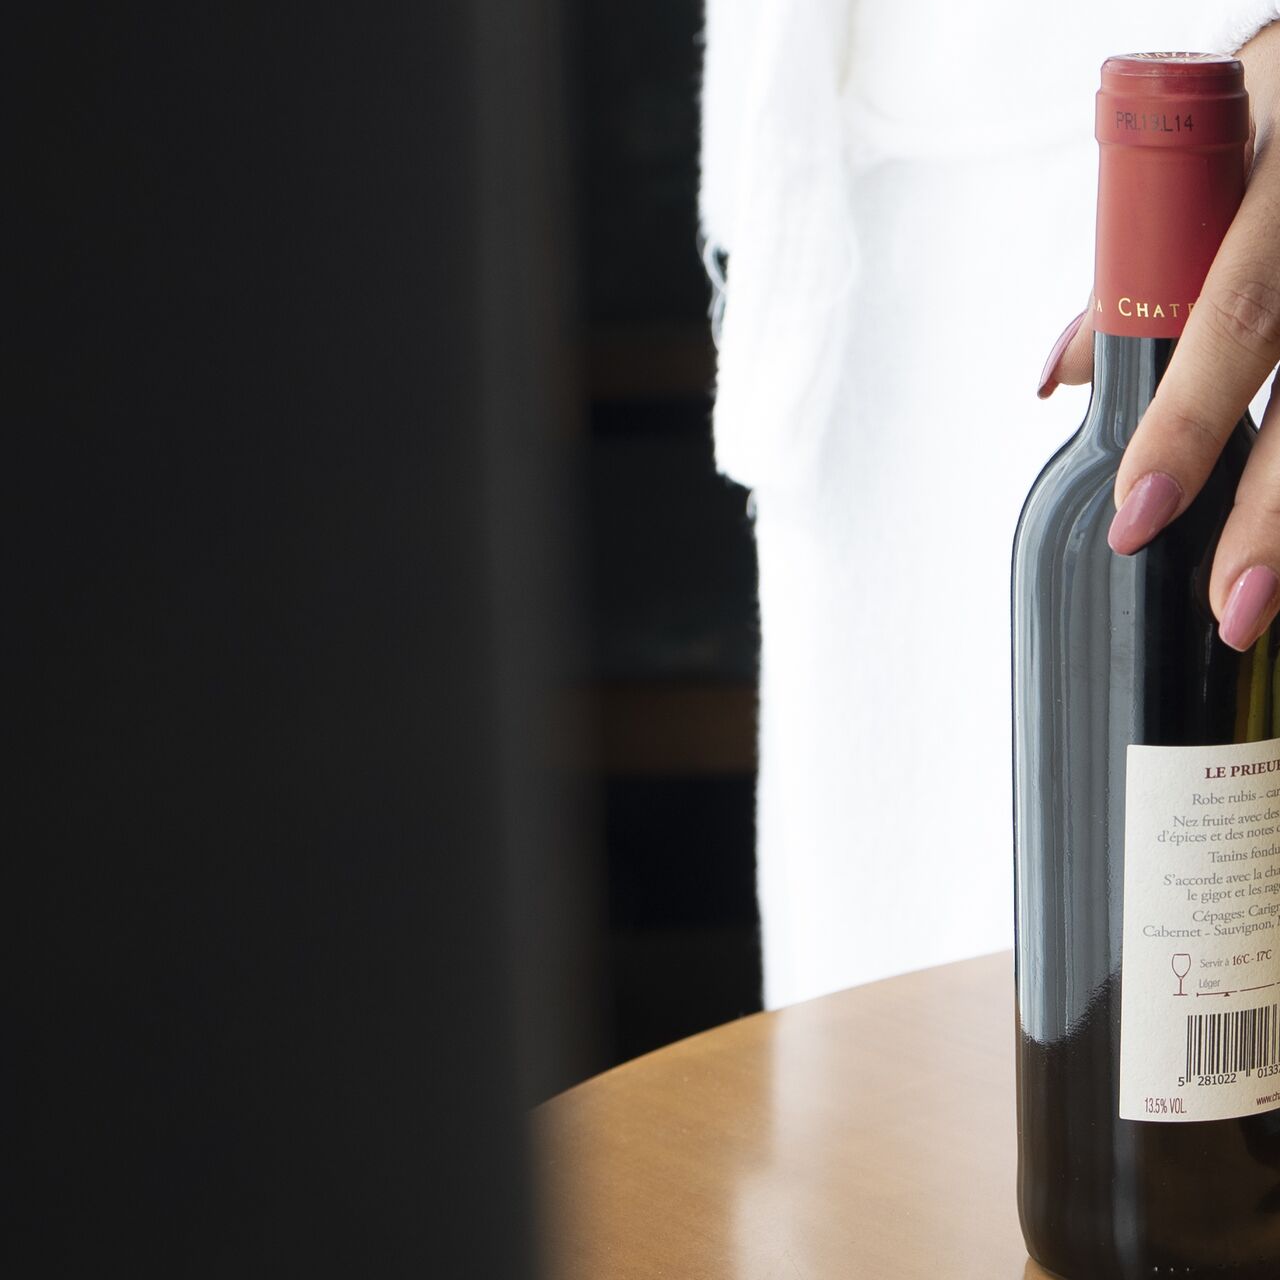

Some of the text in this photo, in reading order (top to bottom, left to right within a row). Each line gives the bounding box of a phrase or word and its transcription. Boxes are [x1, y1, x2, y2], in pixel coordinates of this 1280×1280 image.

[1205, 766, 1226, 779] LE
[1192, 792, 1225, 806] Robe
[1228, 789, 1257, 804] rubis
[1173, 814, 1199, 828] Nez
[1202, 813, 1235, 827] fruité
[1237, 812, 1262, 824] avec
[1264, 807, 1280, 821] des
[1210, 830, 1222, 842] et
[1224, 827, 1244, 841] des
[1247, 823, 1274, 838] notes
[1207, 849, 1248, 864] Tanins
[1225, 872, 1252, 884] avec
[1253, 868, 1263, 881] la
[1187, 889, 1198, 901] le
[1201, 888, 1231, 904] gigot
[1234, 887, 1246, 898] et
[1248, 883, 1262, 896] les
[1192, 908, 1245, 925] Cépages:
[1142, 924, 1202, 938] Cabernet
[1213, 921, 1275, 937] Sauvignon,
[1200, 957, 1223, 969] Servir
[1224, 958, 1230, 967] à
[1199, 977, 1221, 990] Léger
[1177, 1076, 1185, 1087] 5
[1197, 1073, 1237, 1087] 281022
[1144, 1097, 1187, 1115] 13.5% VOL.
